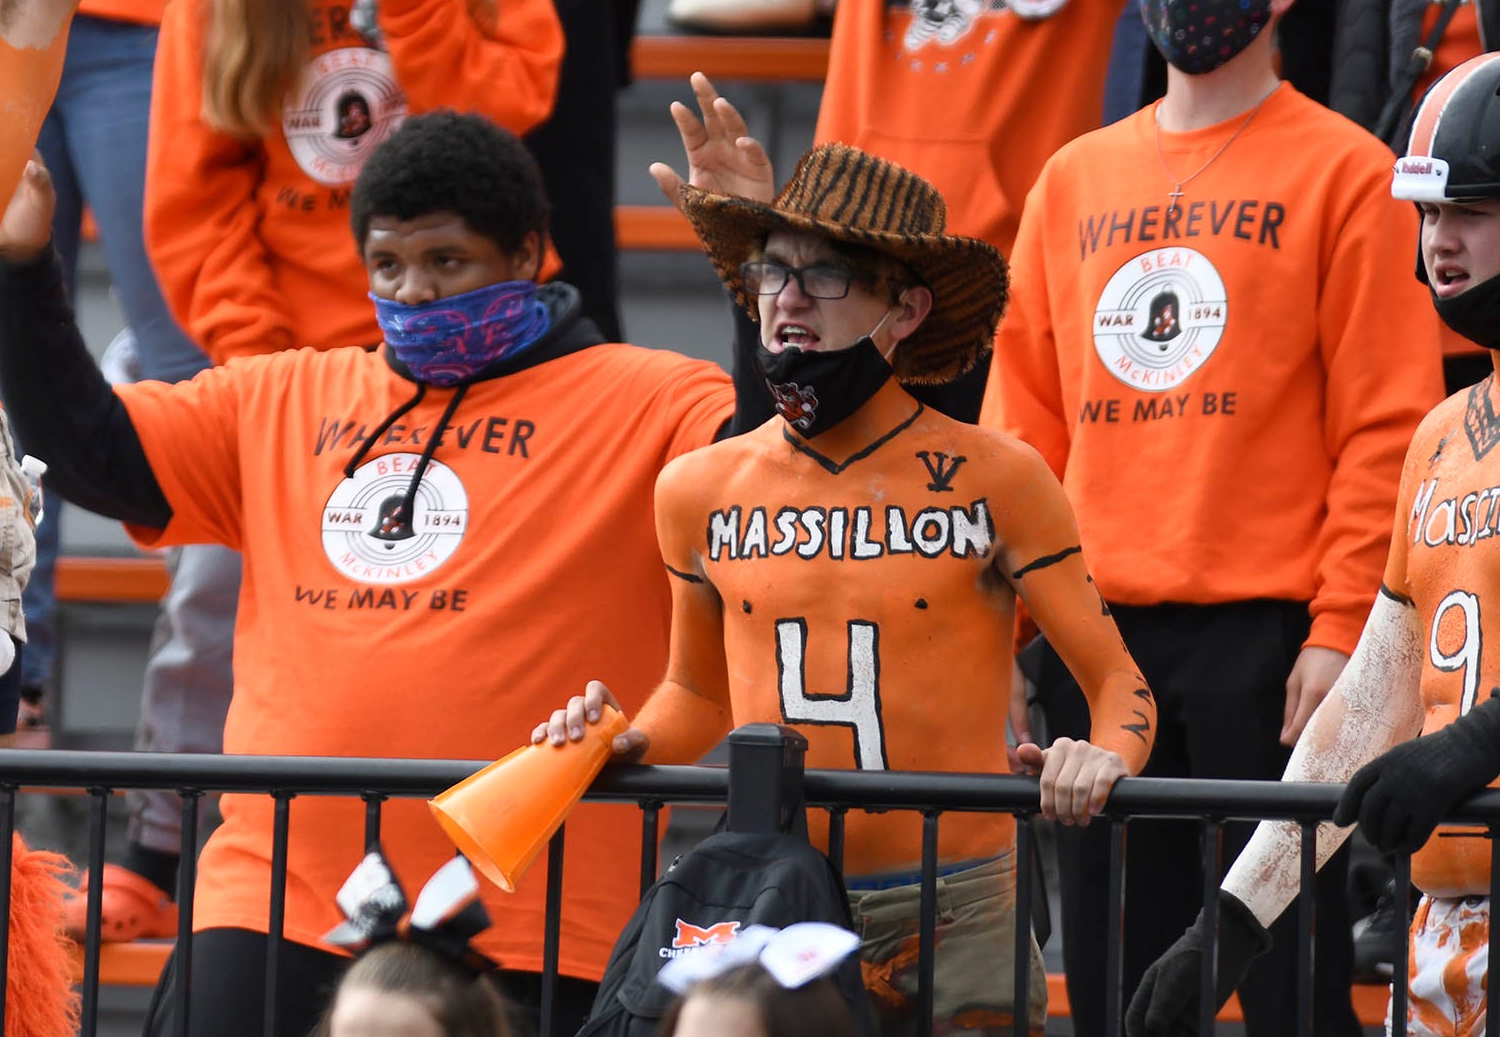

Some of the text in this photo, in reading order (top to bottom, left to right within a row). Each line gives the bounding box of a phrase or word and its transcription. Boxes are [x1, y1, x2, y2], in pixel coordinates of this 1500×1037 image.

[1078, 199, 1287, 263] WHEREVER
[1140, 250, 1196, 274] BEAT
[1099, 314, 1134, 327] WAR
[1188, 307, 1222, 320] 1894
[1079, 391, 1238, 424] WE MAY BE
[327, 512, 364, 524] WAR
[423, 514, 461, 527] 1894
[707, 497, 995, 561] MASSILLON
[338, 550, 439, 579] McKINLEY
[294, 585, 469, 612] WE MAY BE
[1430, 589, 1483, 717] 9
[775, 616, 891, 771] 4
